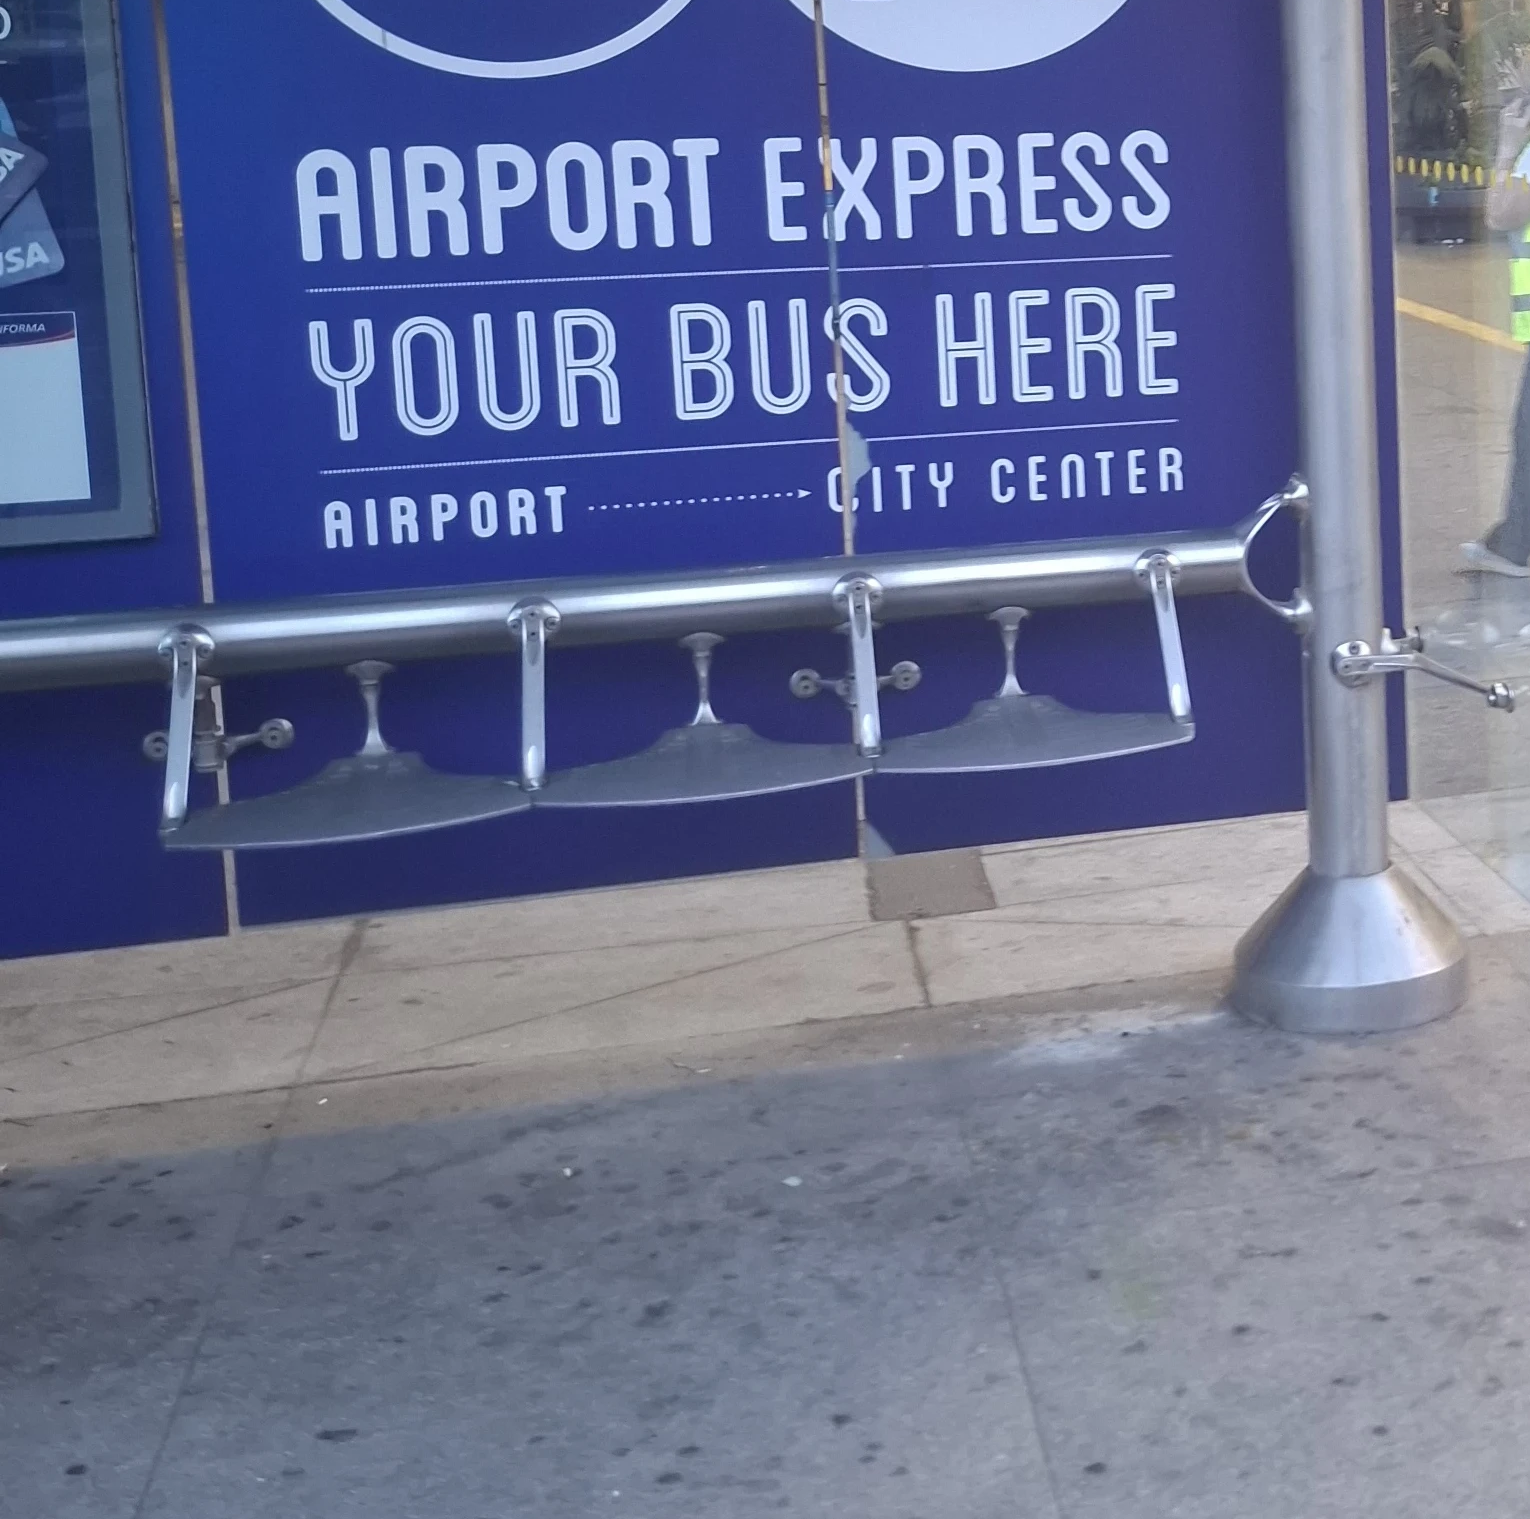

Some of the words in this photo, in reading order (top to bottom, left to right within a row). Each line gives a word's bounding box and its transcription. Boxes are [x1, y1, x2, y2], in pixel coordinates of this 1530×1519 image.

[296, 138, 719, 261] AIRPORT
[764, 130, 1171, 241] EXPRESS
[309, 309, 621, 440] YOUR
[670, 297, 891, 420] BUS
[936, 284, 1179, 407] HERE
[324, 486, 567, 549] AIRPORT
[828, 461, 954, 513] CITY
[990, 447, 1184, 504] CENTER
